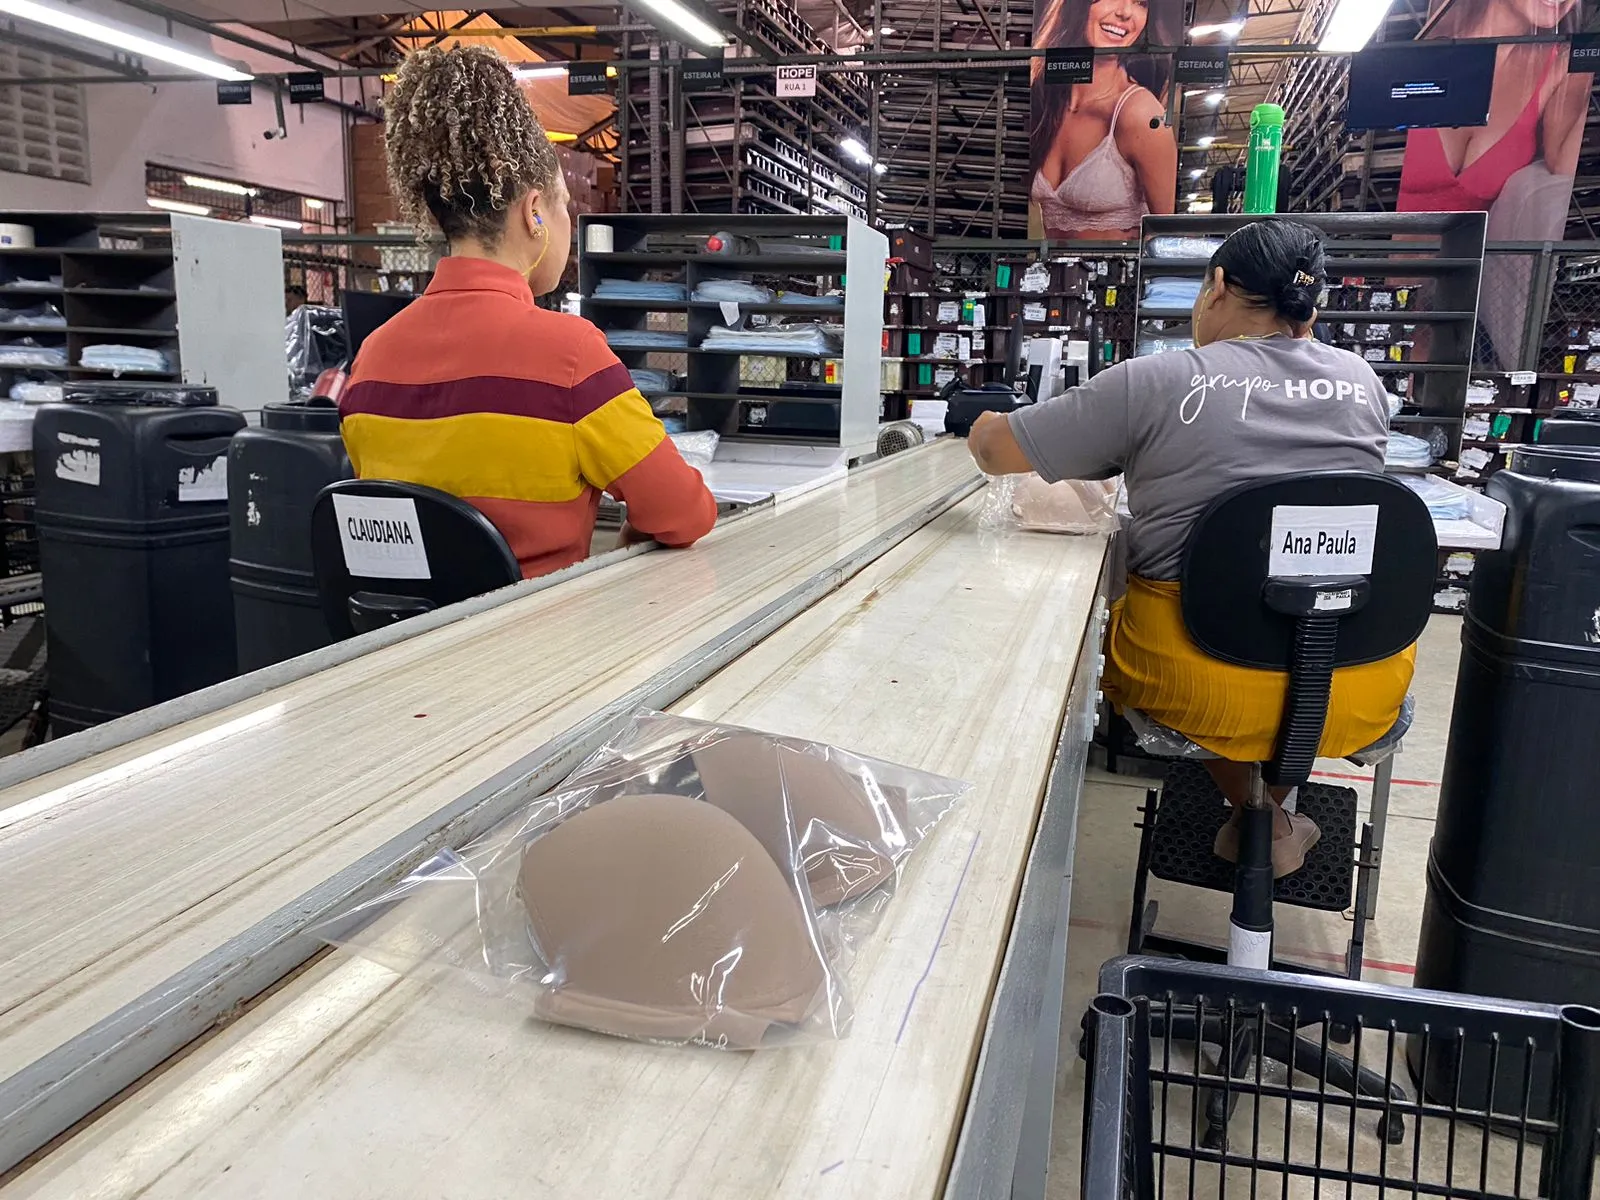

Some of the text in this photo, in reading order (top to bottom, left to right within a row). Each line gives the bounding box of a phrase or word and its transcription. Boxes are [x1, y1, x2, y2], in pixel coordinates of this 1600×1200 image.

[1047, 61, 1091, 70] ESTEIRA 05
[1178, 60, 1224, 69] ESTEIRA 06
[683, 71, 721, 80] ESTEIRA 04
[781, 68, 813, 78] HOPE
[570, 75, 597, 83] ESTEIRA
[291, 84, 315, 92] ESTEIRA
[784, 83, 801, 91] RUA
[1179, 373, 1368, 425] grupo HOPE
[347, 516, 414, 545] CLAUDIANA
[1282, 529, 1357, 555] Ana Paula
